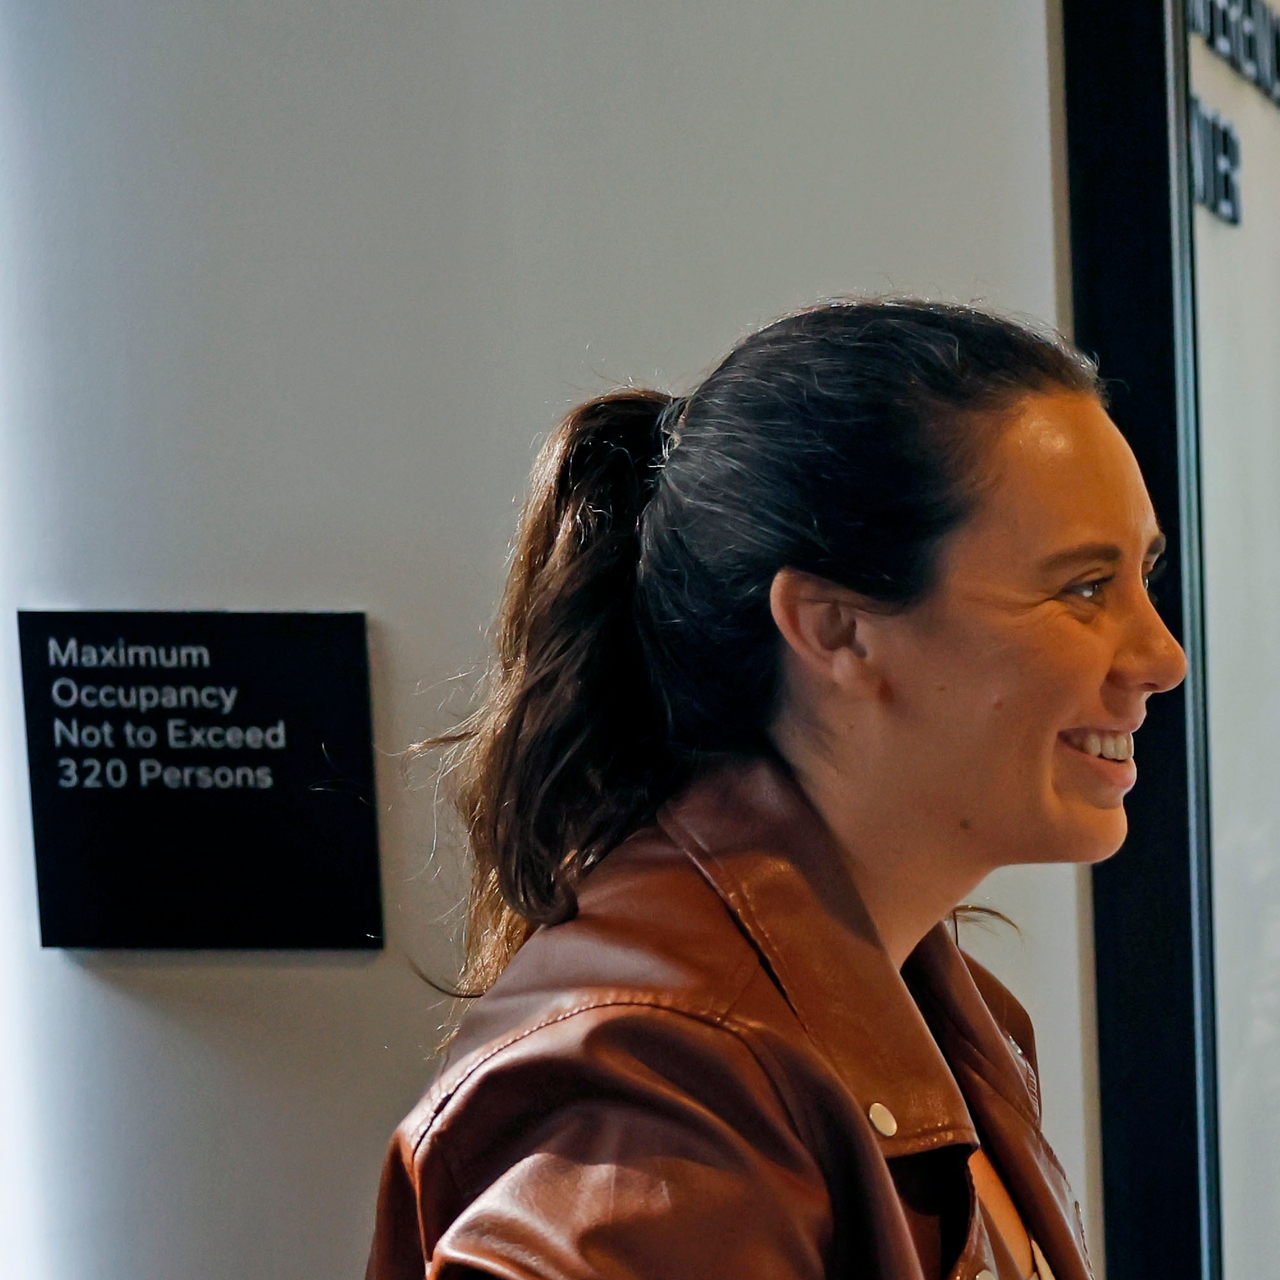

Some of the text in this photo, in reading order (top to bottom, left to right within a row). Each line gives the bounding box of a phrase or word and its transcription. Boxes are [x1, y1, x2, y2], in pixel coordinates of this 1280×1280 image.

[48, 637, 210, 667] Maximum
[51, 677, 238, 713] Occupancy
[53, 718, 287, 749] Not to Exceed
[57, 758, 272, 789] 320 Persons
